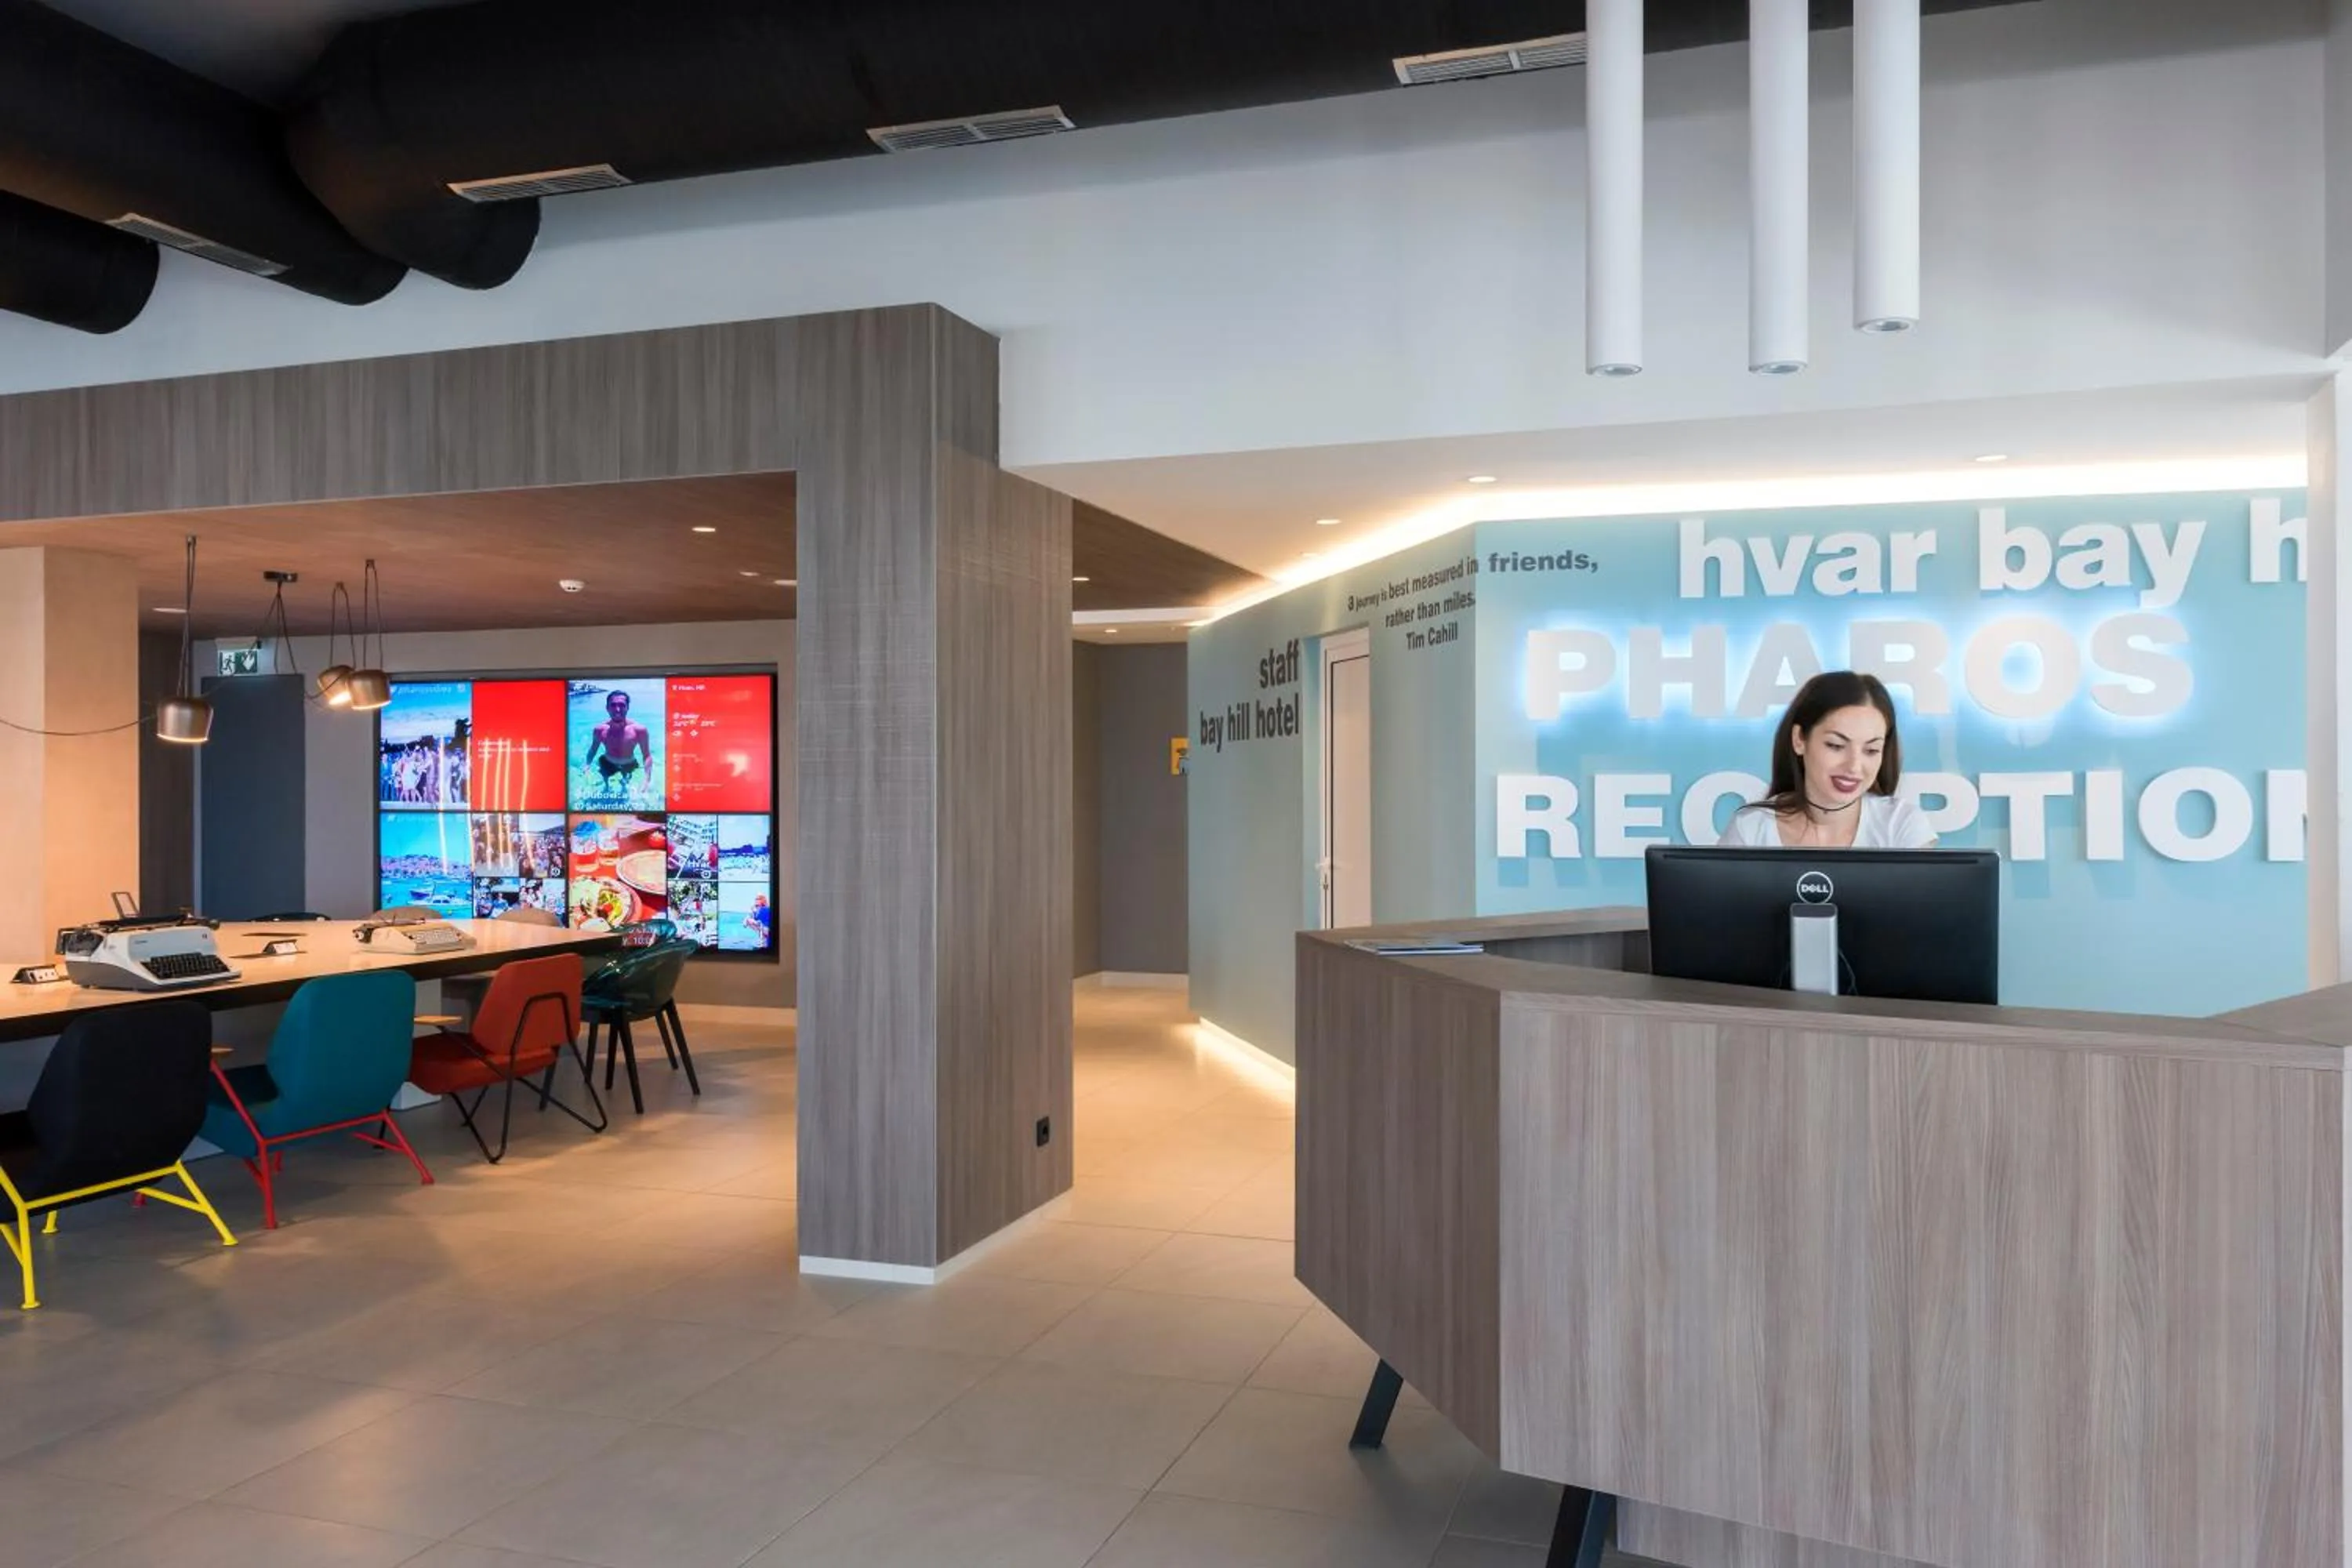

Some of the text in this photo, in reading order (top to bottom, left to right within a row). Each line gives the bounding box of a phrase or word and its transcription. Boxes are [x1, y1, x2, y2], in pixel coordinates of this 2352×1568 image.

[1348, 550, 1599, 612] a journey is best measured in friends,
[1680, 518, 1936, 599] hvar
[1977, 506, 2208, 609] bay
[1385, 606, 1415, 628] rather
[1417, 601, 1440, 621] than
[1406, 621, 1458, 651] Tim Cahill
[1259, 638, 1299, 688] staff
[1526, 612, 2194, 720] PHAROS
[1200, 692, 1299, 753] bay hill hotel
[1801, 883, 1829, 894] DELL
